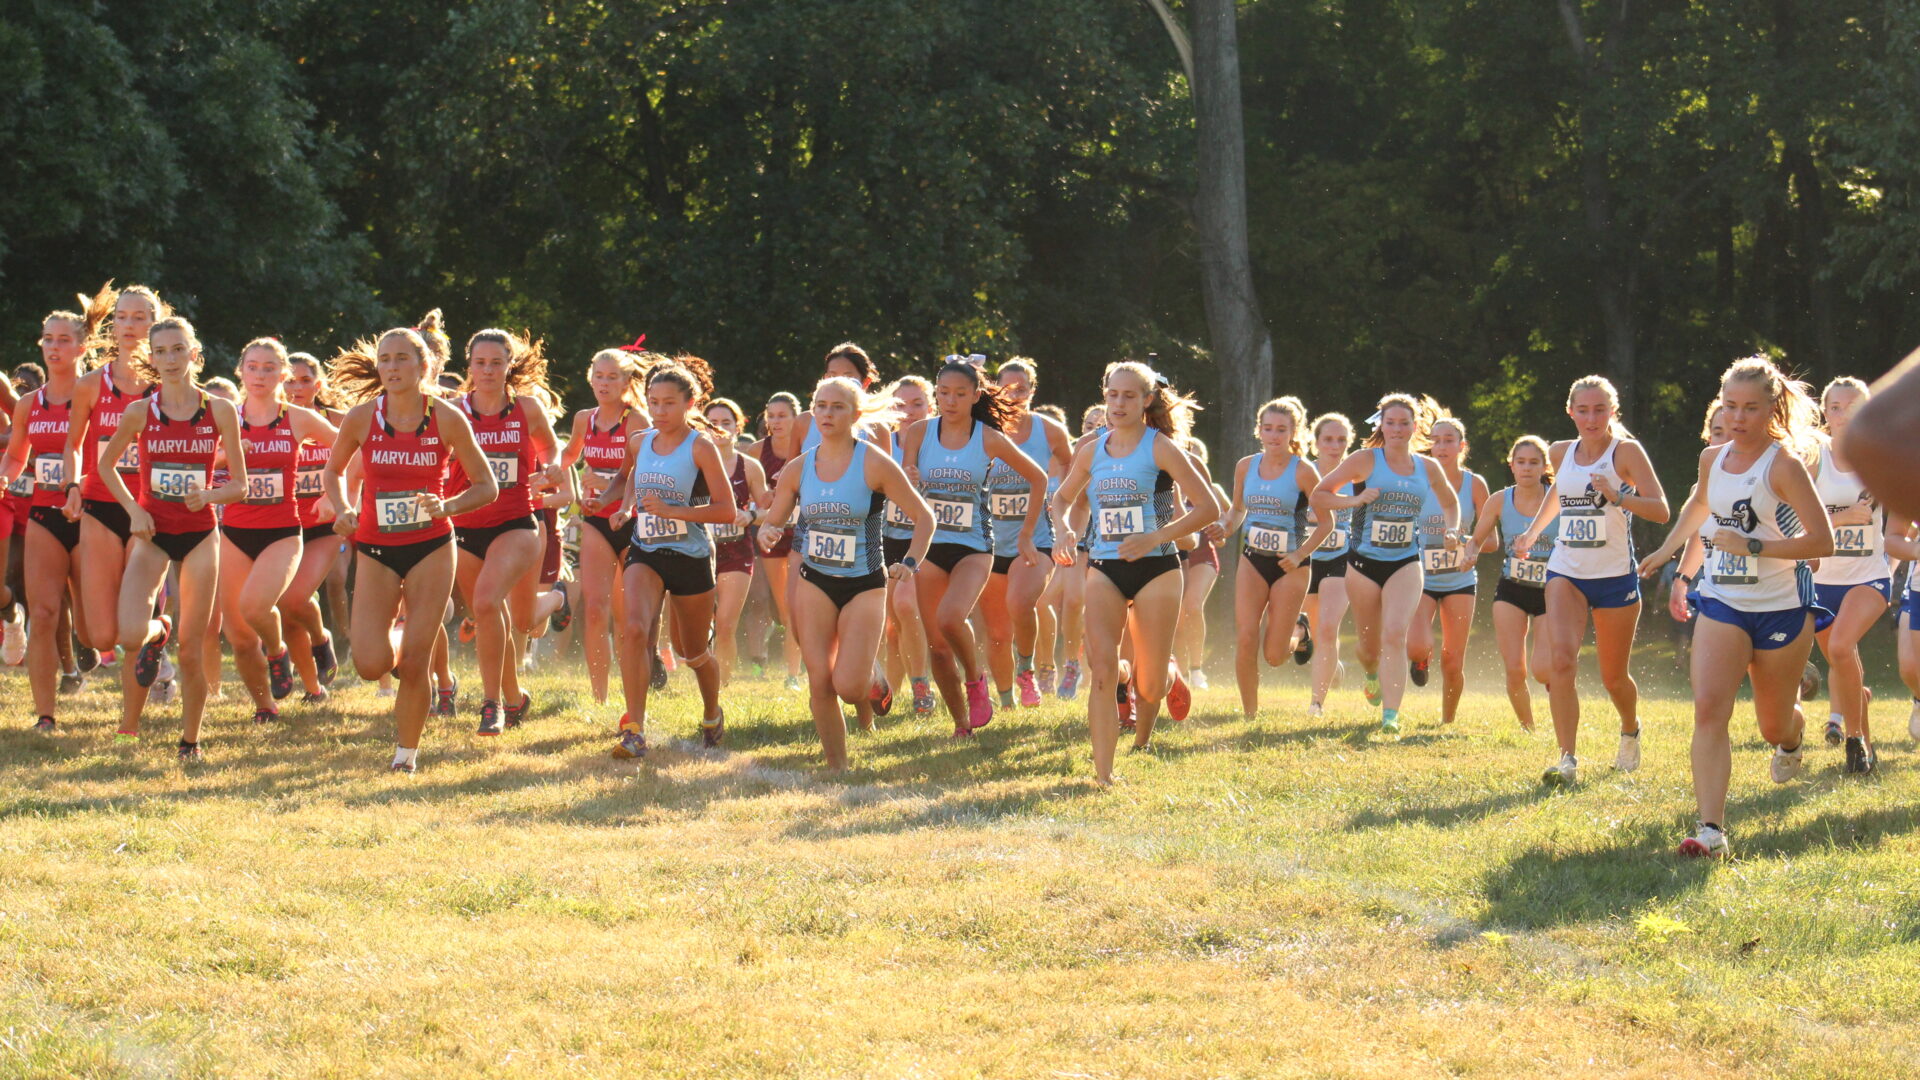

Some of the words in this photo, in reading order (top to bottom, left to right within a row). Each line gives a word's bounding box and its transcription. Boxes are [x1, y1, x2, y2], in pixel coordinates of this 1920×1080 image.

[147, 439, 215, 454] MARYLAND
[474, 430, 520, 445] ARYLAND
[371, 449, 438, 467] MARYLAND
[928, 467, 971, 482] JOHNS
[1097, 477, 1137, 491] JOHNS
[806, 502, 850, 516] JOHNS
[933, 502, 964, 526] 502
[998, 496, 1028, 515] 512
[645, 515, 677, 537] 505
[1104, 510, 1134, 534] 514
[1566, 519, 1597, 541] 430
[1254, 531, 1280, 551] 498
[1378, 524, 1407, 543] 508
[1834, 529, 1864, 550] 424
[815, 535, 846, 561] 504
[1431, 550, 1459, 569] 517
[1516, 561, 1545, 582] 513
